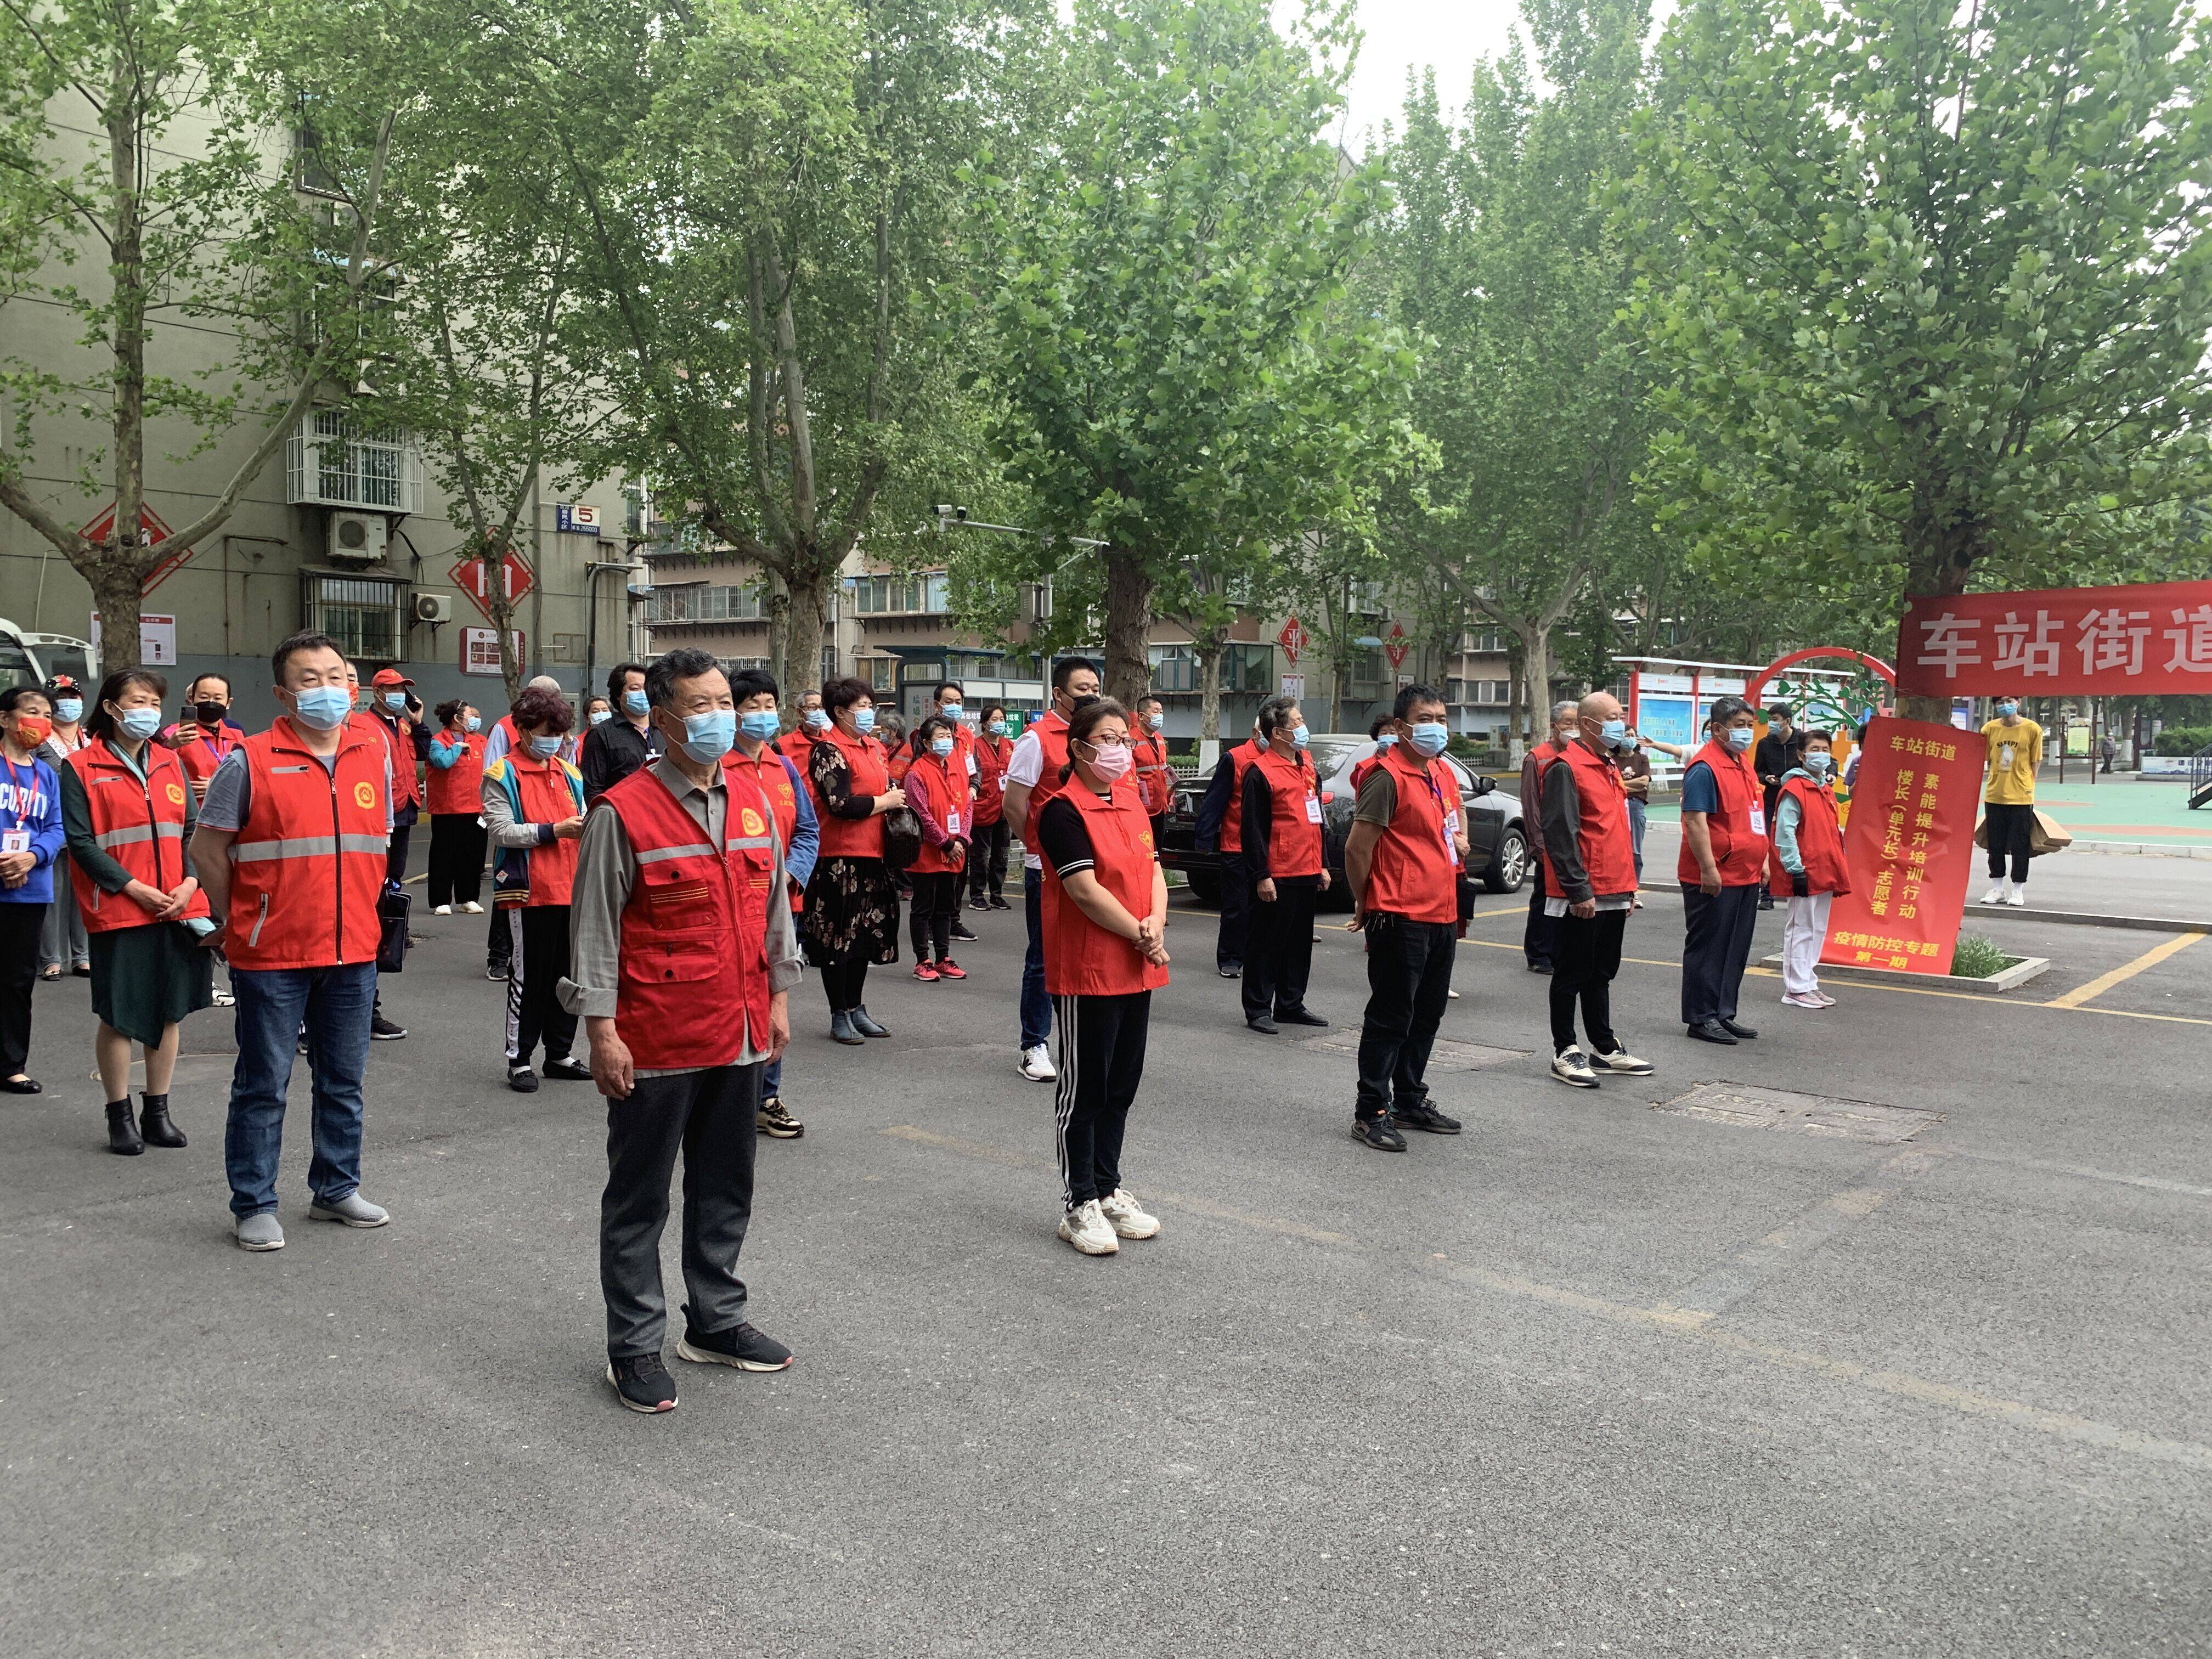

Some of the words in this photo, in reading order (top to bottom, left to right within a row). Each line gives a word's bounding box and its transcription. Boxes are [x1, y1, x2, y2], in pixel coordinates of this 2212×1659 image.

[579, 507, 592, 522] 5
[1917, 604, 2212, 678] 车站街道
[1890, 735, 1956, 761] 车站街道
[1898, 773, 1940, 919] 素能提升培训行动
[1833, 931, 1940, 957] 疫情防控专题
[1854, 951, 1908, 969] 第一期
